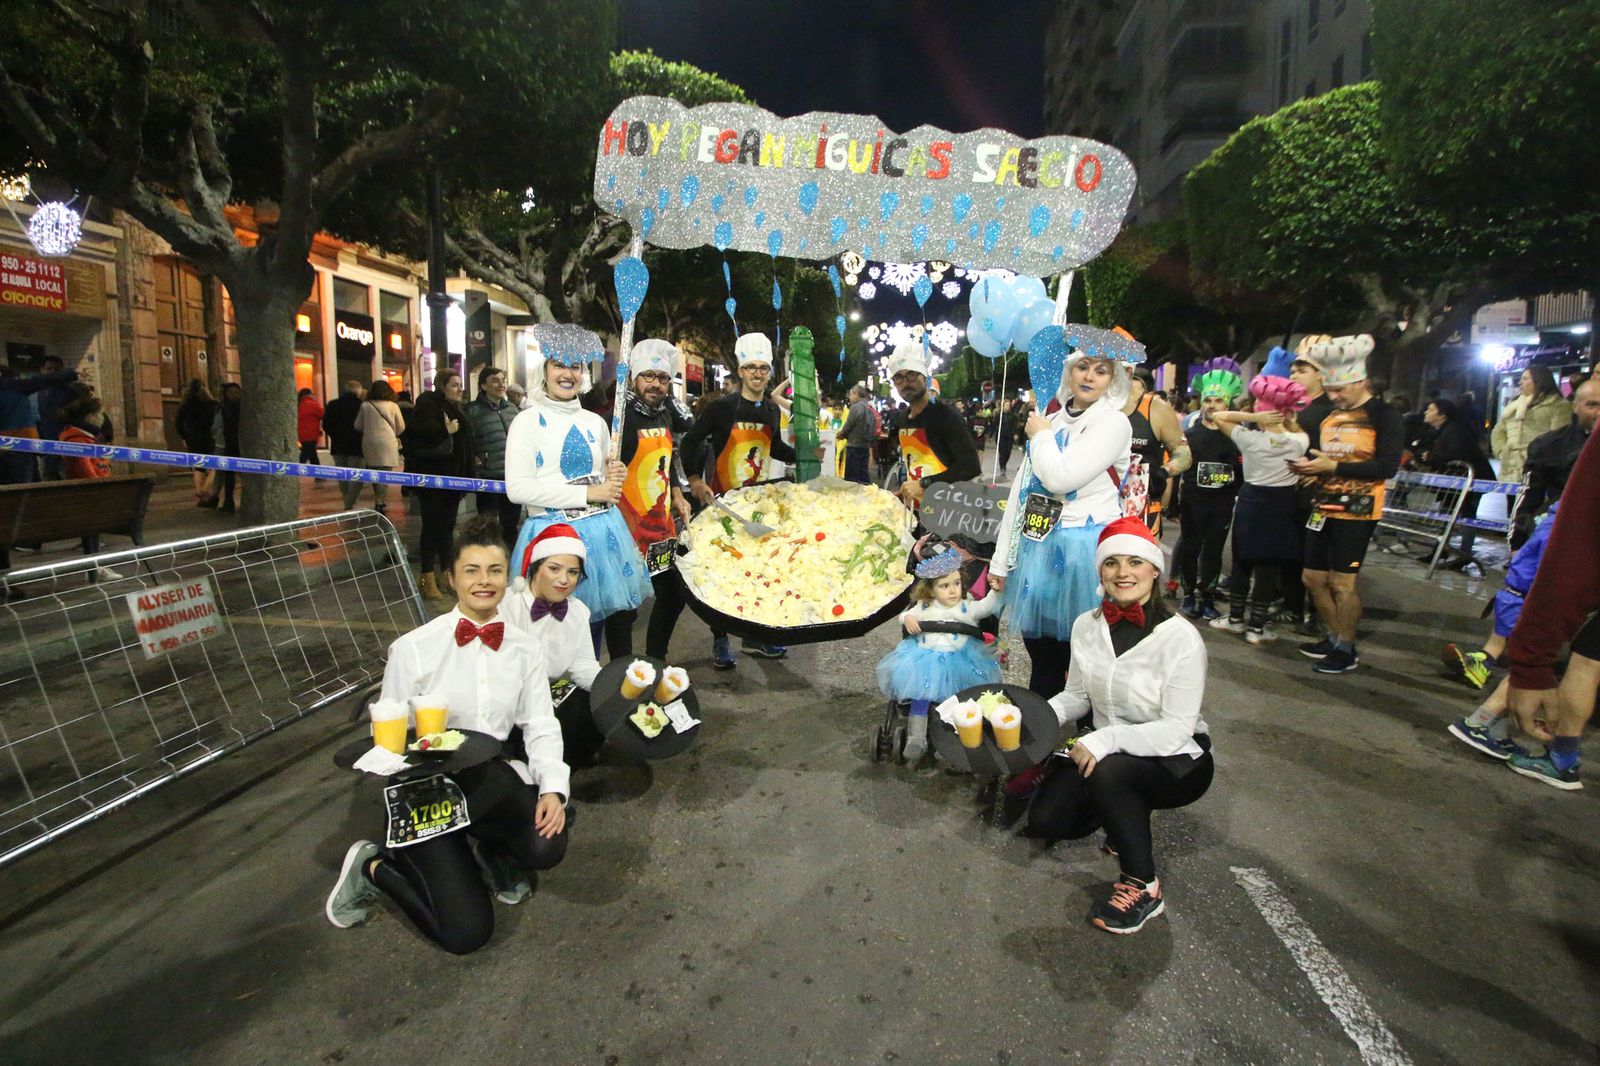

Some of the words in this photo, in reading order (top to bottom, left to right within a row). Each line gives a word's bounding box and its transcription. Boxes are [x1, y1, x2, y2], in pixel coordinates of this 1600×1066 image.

[604, 119, 671, 157] HOY
[680, 120, 786, 169] PEGAN
[1, 255, 19, 271] 950
[9, 273, 32, 288] ALQUILA
[35, 279, 62, 294] LOCAL
[336, 321, 374, 346] Orange
[1027, 512, 1050, 530] 1881
[137, 588, 186, 612] ALYSER
[186, 583, 205, 599] DE
[136, 602, 216, 635] MAQUINARIA
[410, 800, 452, 825] 1700
